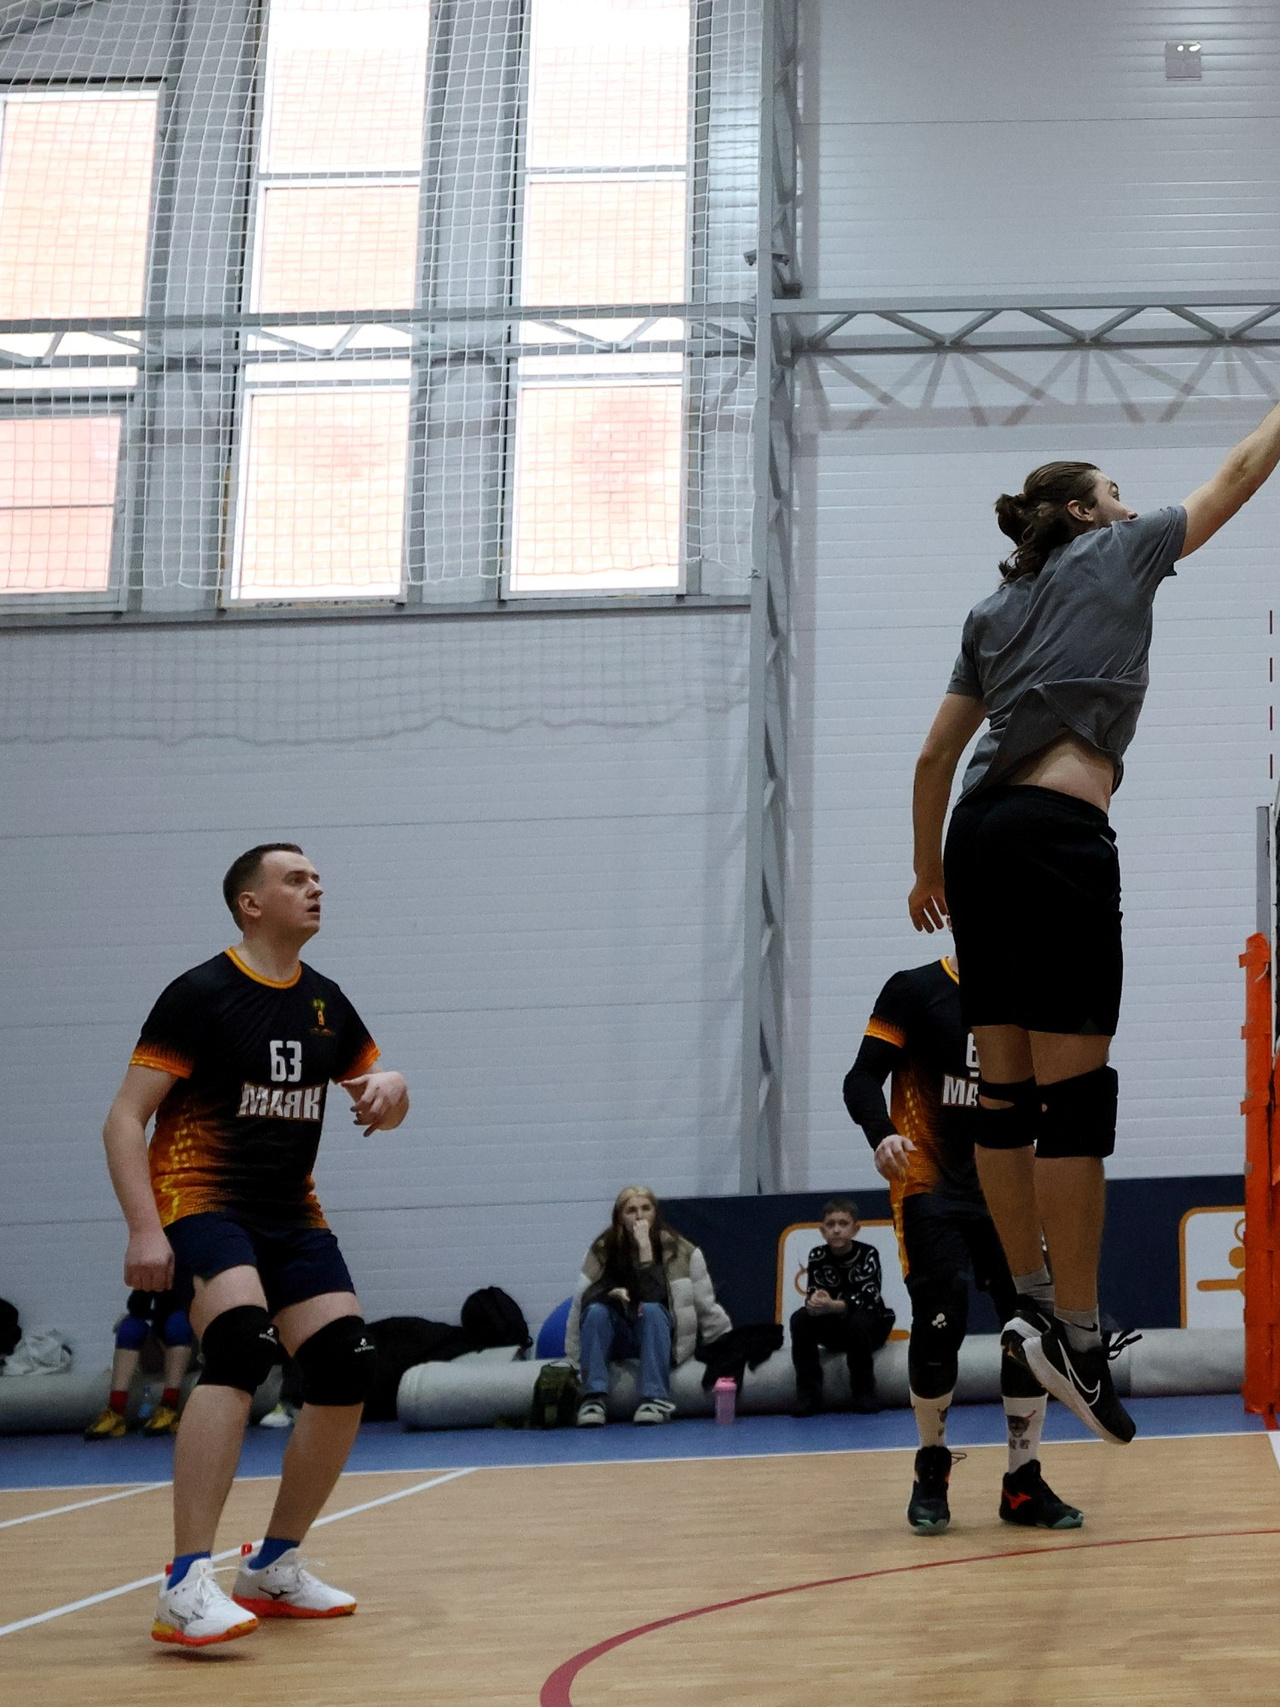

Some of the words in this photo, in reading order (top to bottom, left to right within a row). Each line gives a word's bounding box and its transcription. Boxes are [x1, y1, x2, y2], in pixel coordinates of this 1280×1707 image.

[269, 1039, 302, 1082] 63
[966, 1032, 980, 1068] 6
[238, 1083, 322, 1120] МАЯК
[942, 1074, 979, 1107] МА
